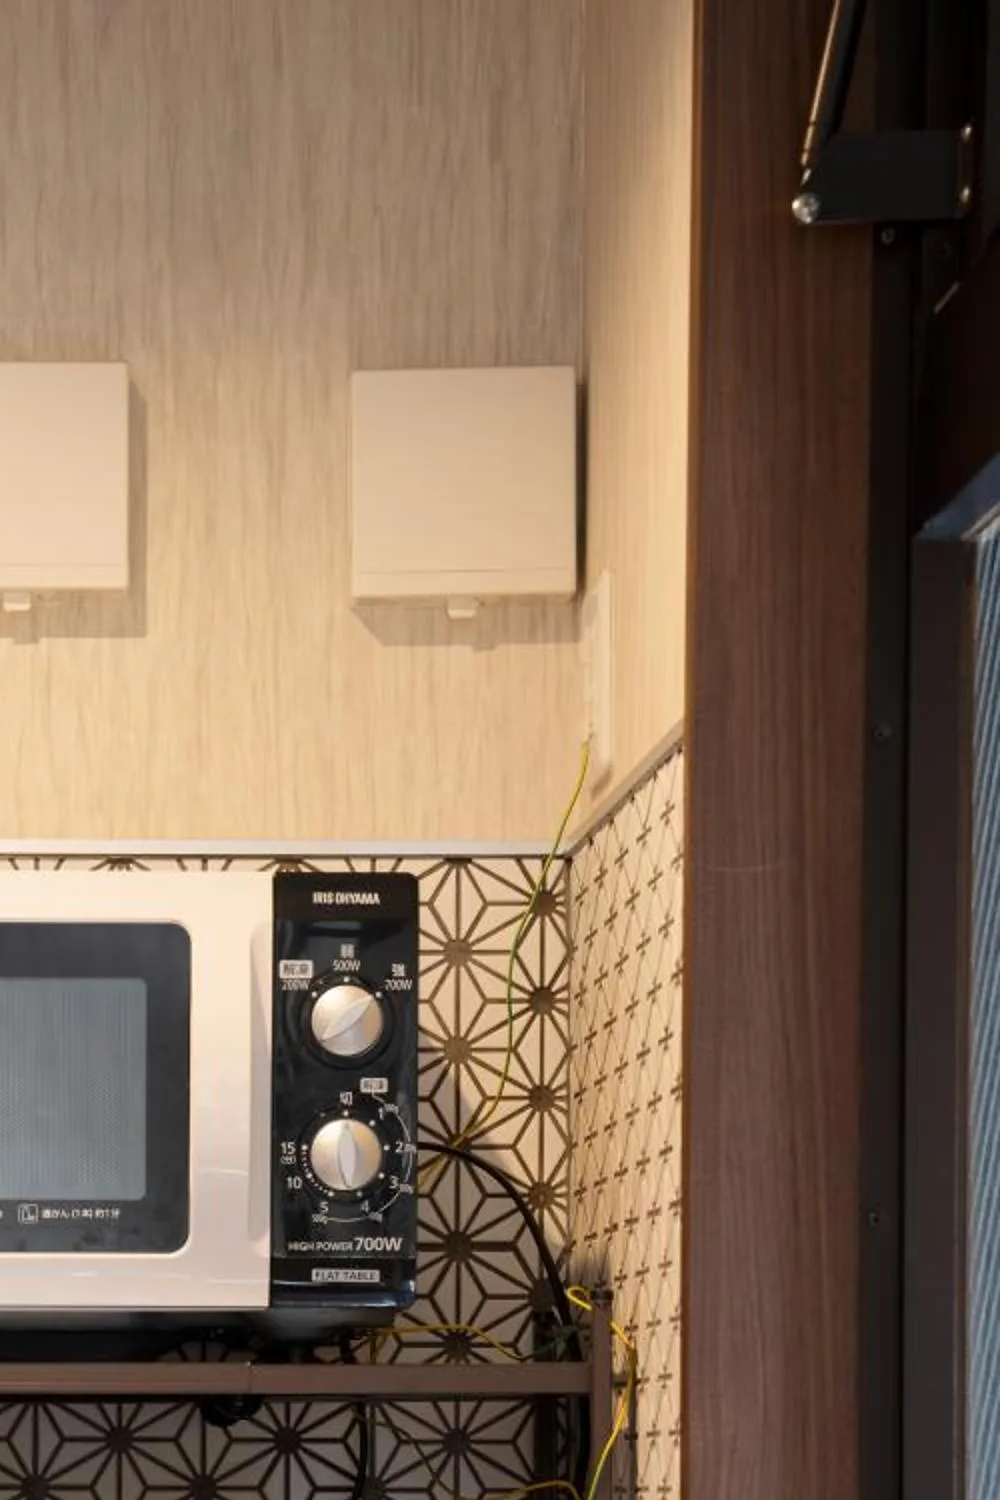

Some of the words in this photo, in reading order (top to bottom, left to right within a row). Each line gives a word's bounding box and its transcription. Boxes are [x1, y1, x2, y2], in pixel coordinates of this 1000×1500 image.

[312, 891, 334, 905] IRIS
[335, 891, 381, 905] OHYAMA
[332, 959, 361, 972] 500W
[384, 978, 413, 992] 700W
[377, 1107, 385, 1119] 1
[279, 1142, 296, 1155] 15
[394, 1141, 403, 1153] 2
[285, 1176, 302, 1189] 10
[388, 1175, 399, 1189] 3
[319, 1201, 329, 1213] 5
[360, 1201, 370, 1213] 4
[287, 1240, 315, 1251] HIGH
[315, 1240, 353, 1251] POWER
[353, 1236, 404, 1252] 700W
[314, 1270, 341, 1281] FLAT
[341, 1270, 378, 1281] TABLE
